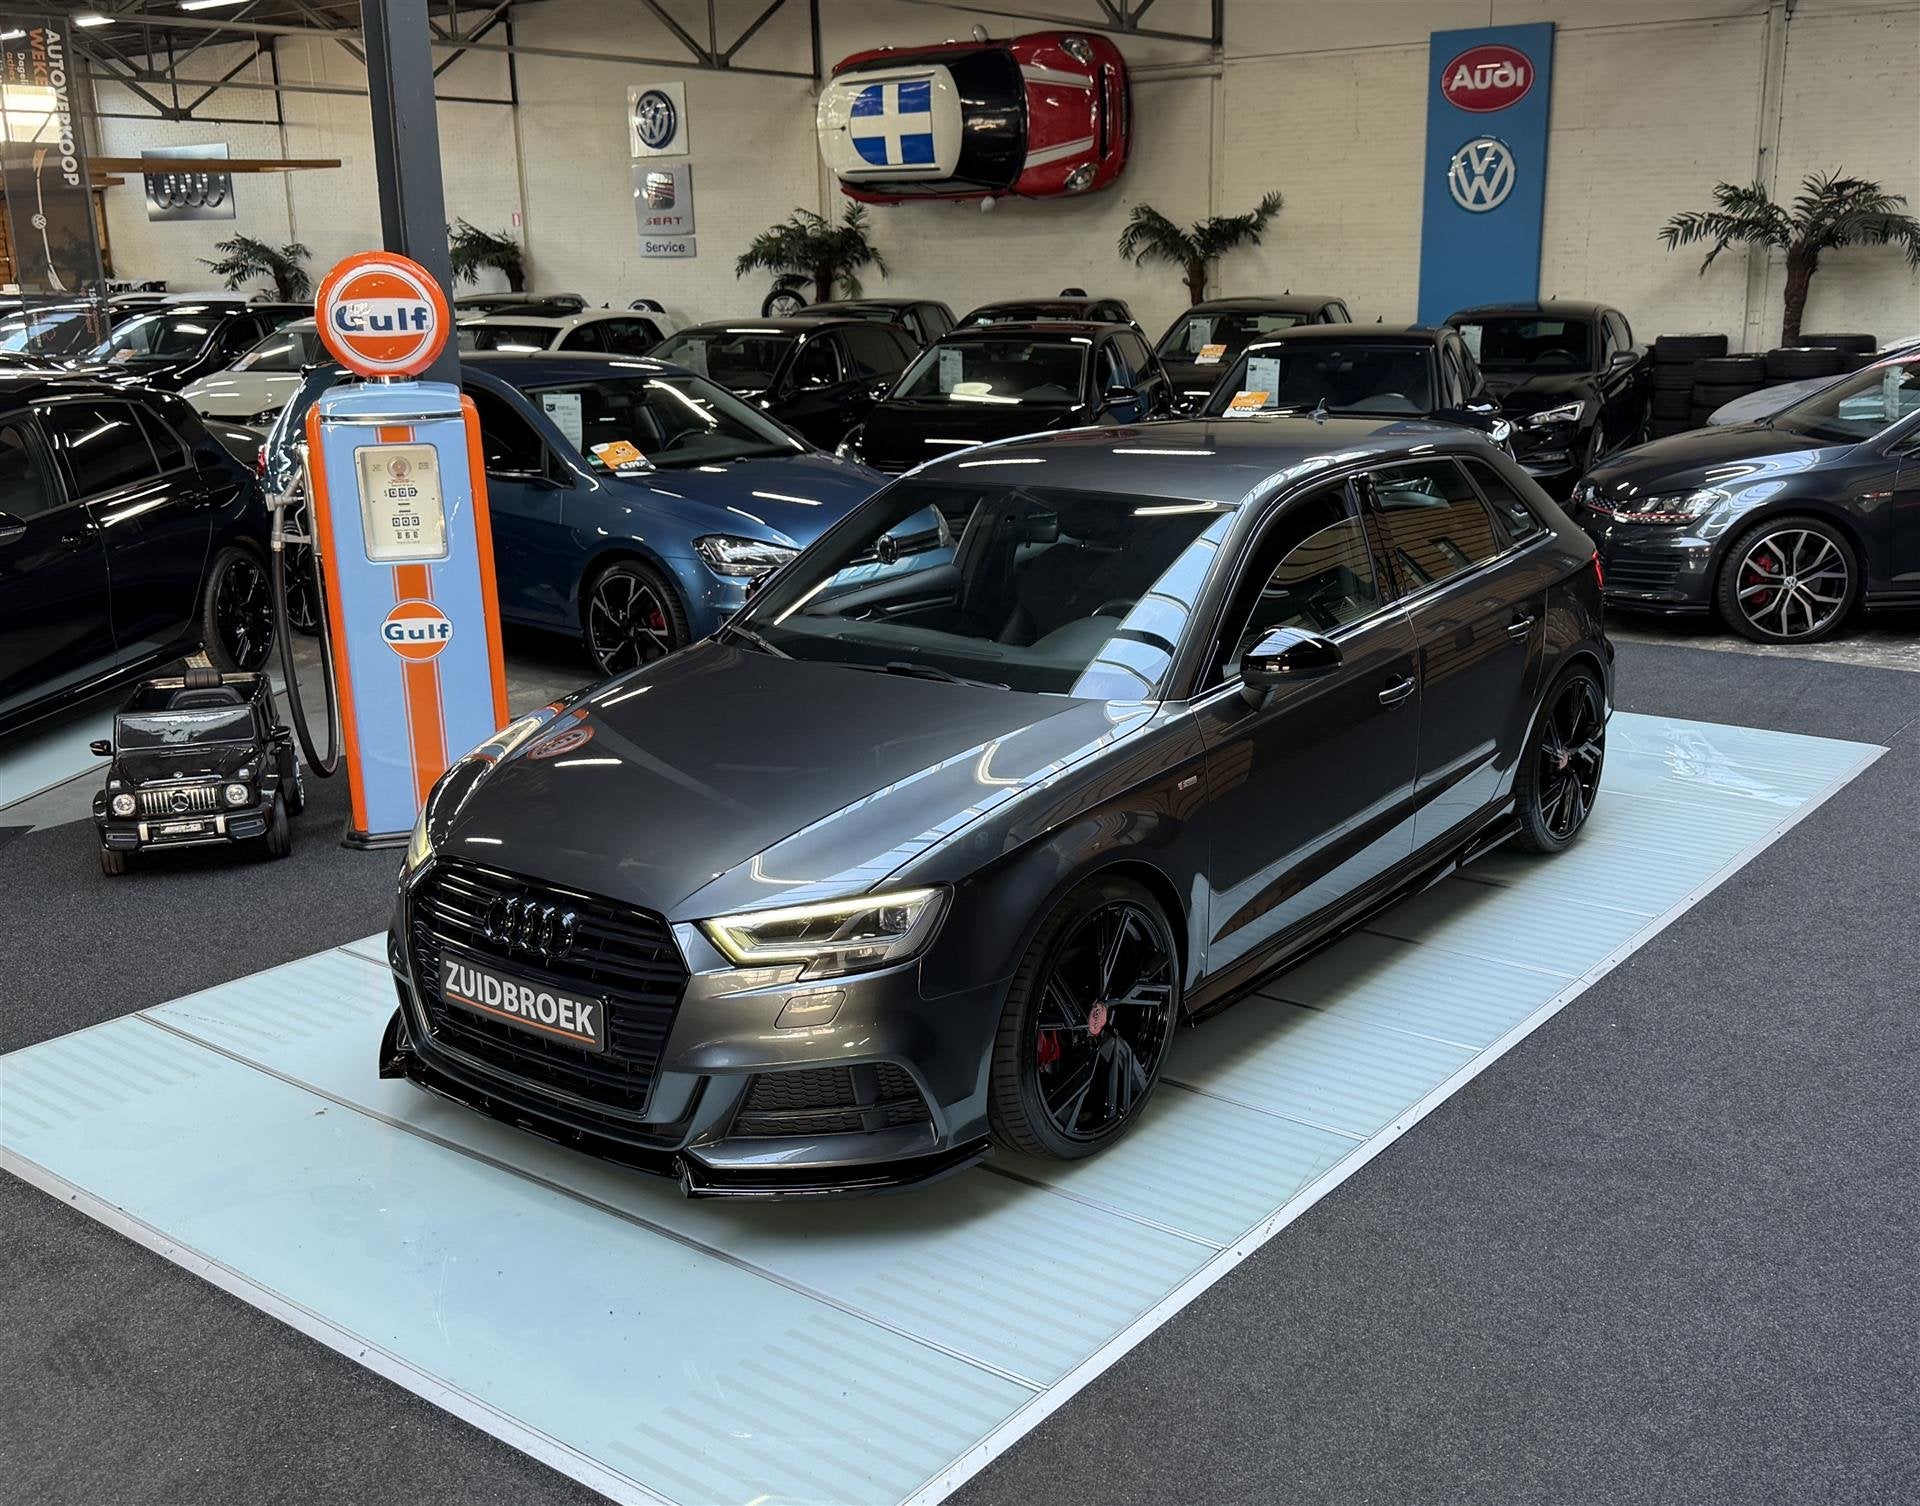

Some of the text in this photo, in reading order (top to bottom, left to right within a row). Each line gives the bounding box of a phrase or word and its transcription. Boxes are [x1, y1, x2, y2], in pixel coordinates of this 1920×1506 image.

[17, 52, 29, 85] Dageli
[29, 27, 49, 86] WEKE
[46, 28, 79, 186] AUTOVERKOOP
[645, 216, 683, 226] SEAT
[645, 241, 686, 253] Service
[335, 306, 428, 332] Gulf
[384, 623, 449, 640] Gulf
[445, 960, 595, 1036] ZUIDBROEK
